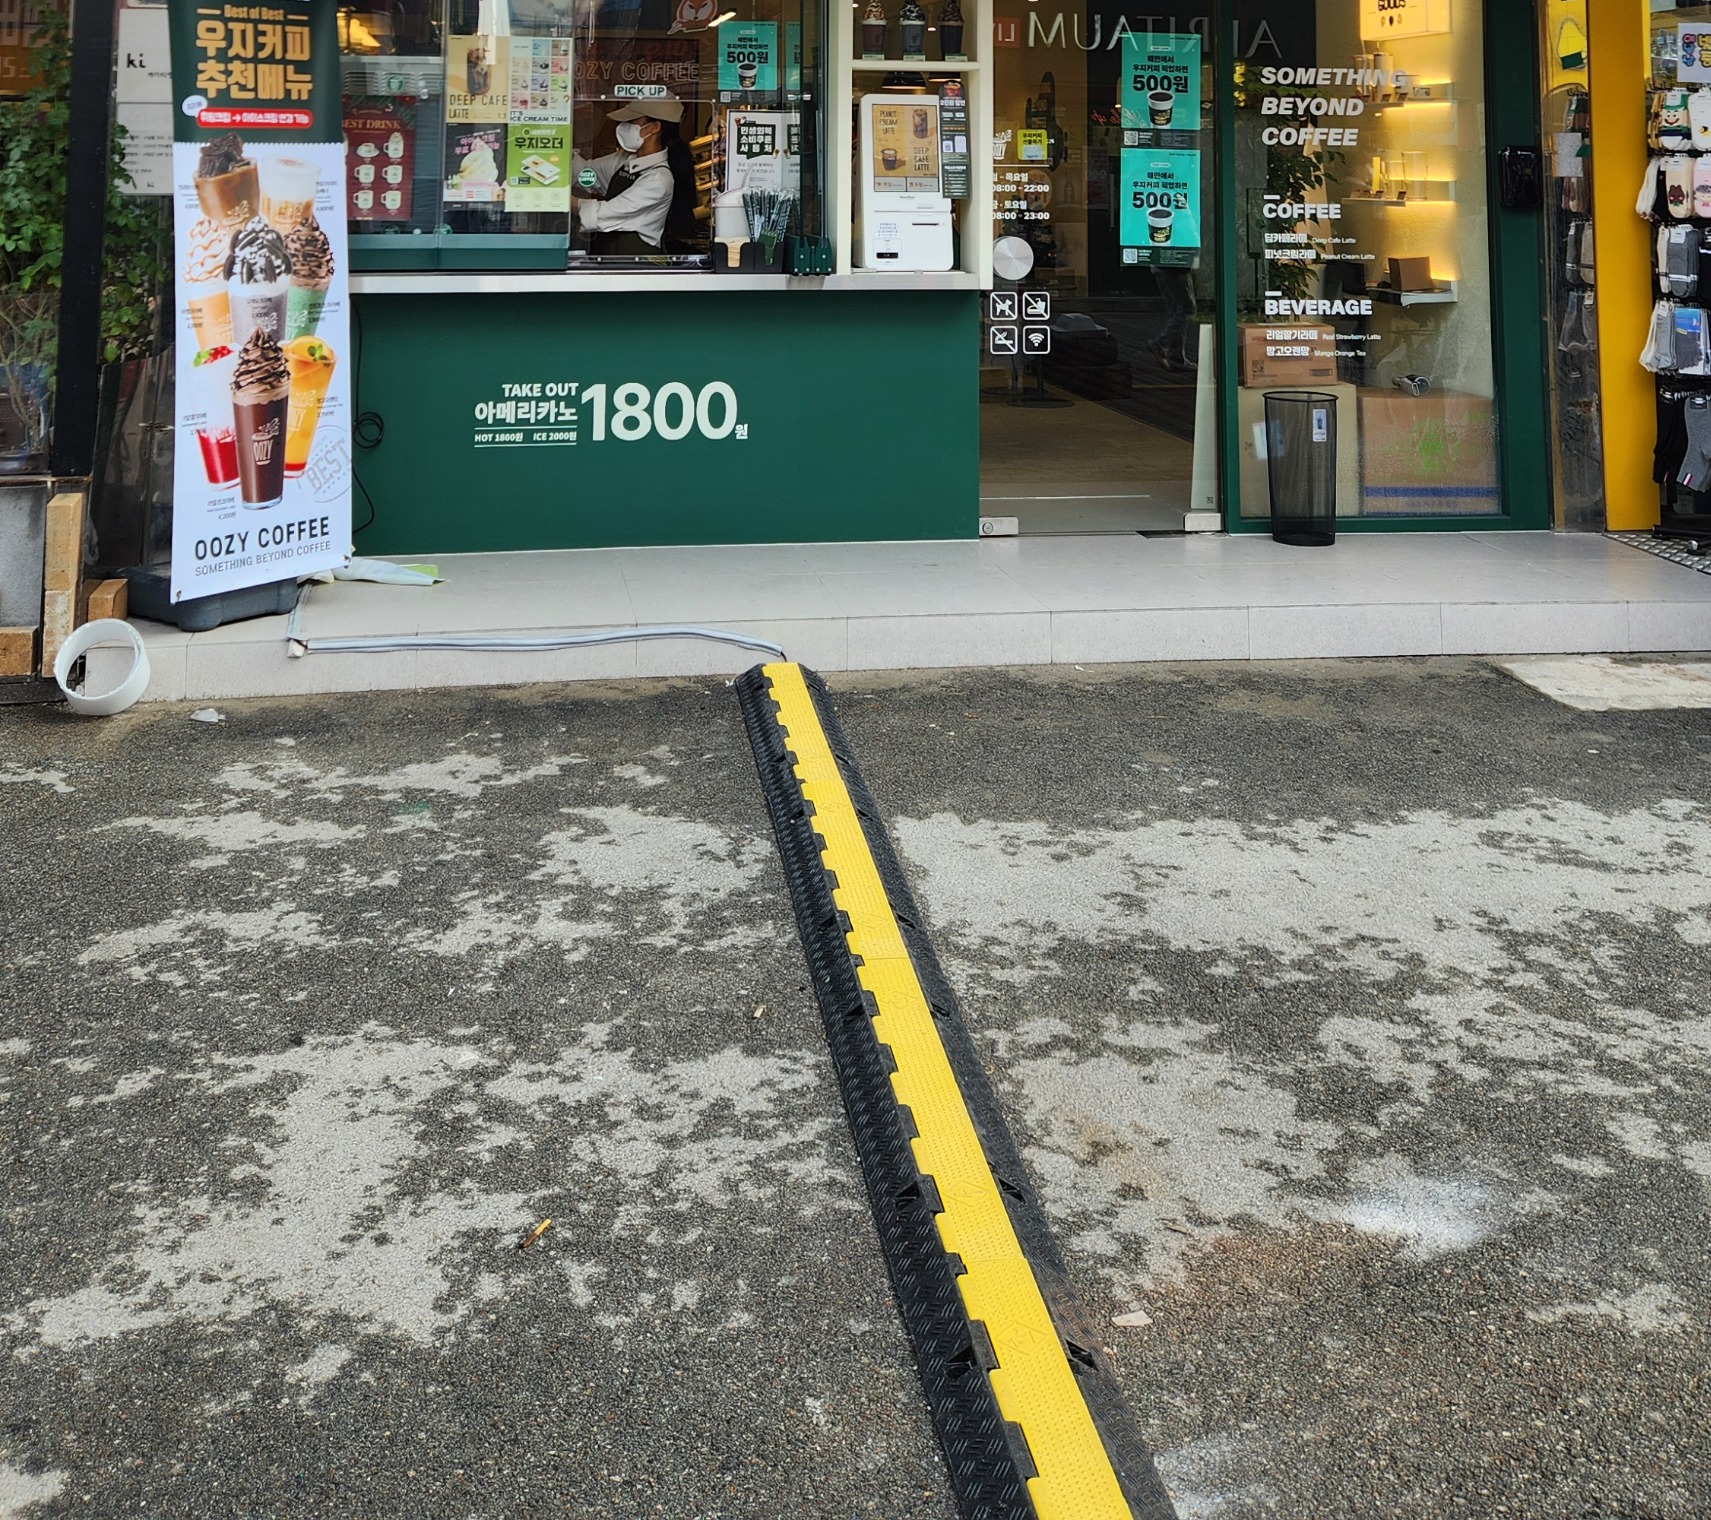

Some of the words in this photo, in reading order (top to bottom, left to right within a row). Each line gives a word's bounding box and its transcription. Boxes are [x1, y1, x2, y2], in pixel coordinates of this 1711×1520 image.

[224, 5, 247, 18] Best
[261, 7, 285, 21] Best
[196, 20, 311, 62] 우지커피
[127, 53, 146, 68] ki
[727, 51, 769, 64] 500원
[621, 62, 700, 81] COFFEE
[1261, 67, 1407, 86] SOMETHING
[196, 59, 313, 101] 추천메뉴
[1133, 75, 1189, 94] 500원
[617, 87, 647, 97] PICK
[651, 87, 666, 97] UP
[450, 95, 476, 106] DEEP
[1261, 98, 1364, 116] BEYOND
[514, 136, 564, 150] 우지오더
[740, 135, 772, 144] 소비쿠폰
[1262, 128, 1359, 146] COFFEE
[1005, 172, 1029, 182] 목요일
[1024, 184, 1050, 192] 22:00
[1004, 200, 1027, 209] 토요일
[1132, 192, 1188, 209] 500원
[1024, 212, 1050, 220] 23:00
[1263, 204, 1341, 219] COFFEE
[1265, 249, 1316, 260] 피넛크림라떼
[1265, 300, 1372, 316] BEVERAGE
[1266, 330, 1318, 340] 리얼딸기라떼
[502, 384, 542, 397] TAKE
[545, 383, 579, 397] OUT
[475, 400, 578, 424] 아메리카노
[475, 434, 493, 442] HOT
[495, 432, 523, 442] 1800원
[533, 433, 547, 441] ICE
[549, 431, 577, 442] 2000원
[253, 439, 273, 462] OOZY
[305, 439, 347, 493] BEST
[194, 532, 249, 561] OOZY
[258, 516, 330, 548] COFFEE
[195, 557, 253, 577] SOMETHING
[256, 549, 293, 565] BEYOND
[296, 540, 331, 556] COFFEE
